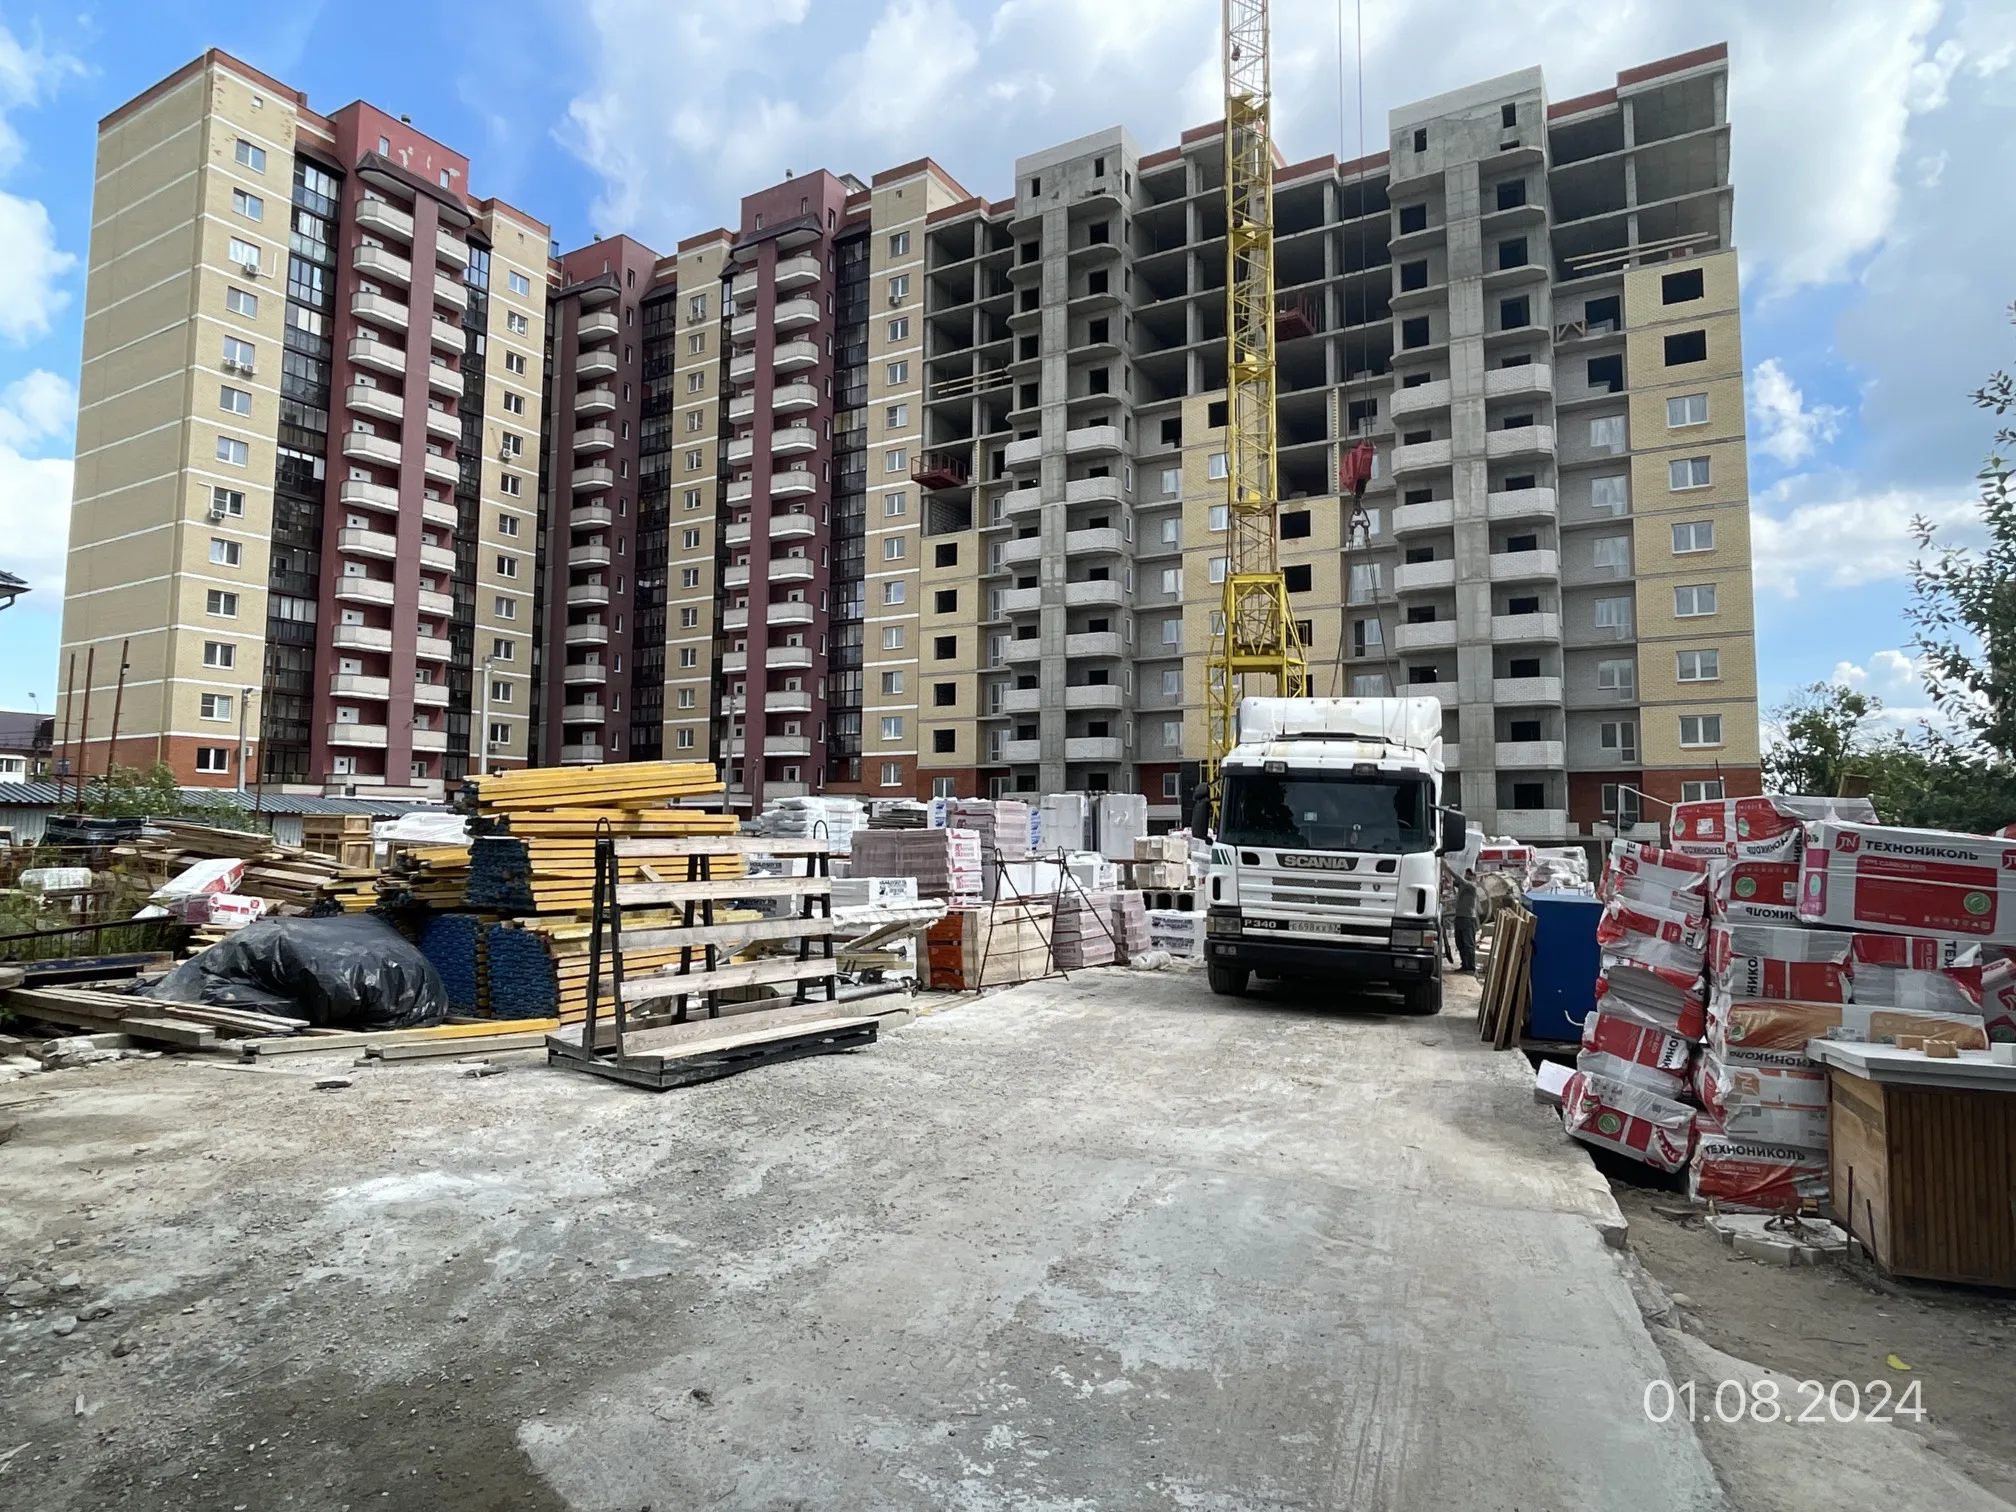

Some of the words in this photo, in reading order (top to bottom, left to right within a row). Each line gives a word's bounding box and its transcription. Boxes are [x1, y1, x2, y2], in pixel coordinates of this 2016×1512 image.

[1865, 840, 1979, 860] ТЕХНОНИКОЛЬ
[1284, 855, 1349, 870] SCANIA
[1704, 1144, 1805, 1161] ТЕХНОНИКОЛЬ
